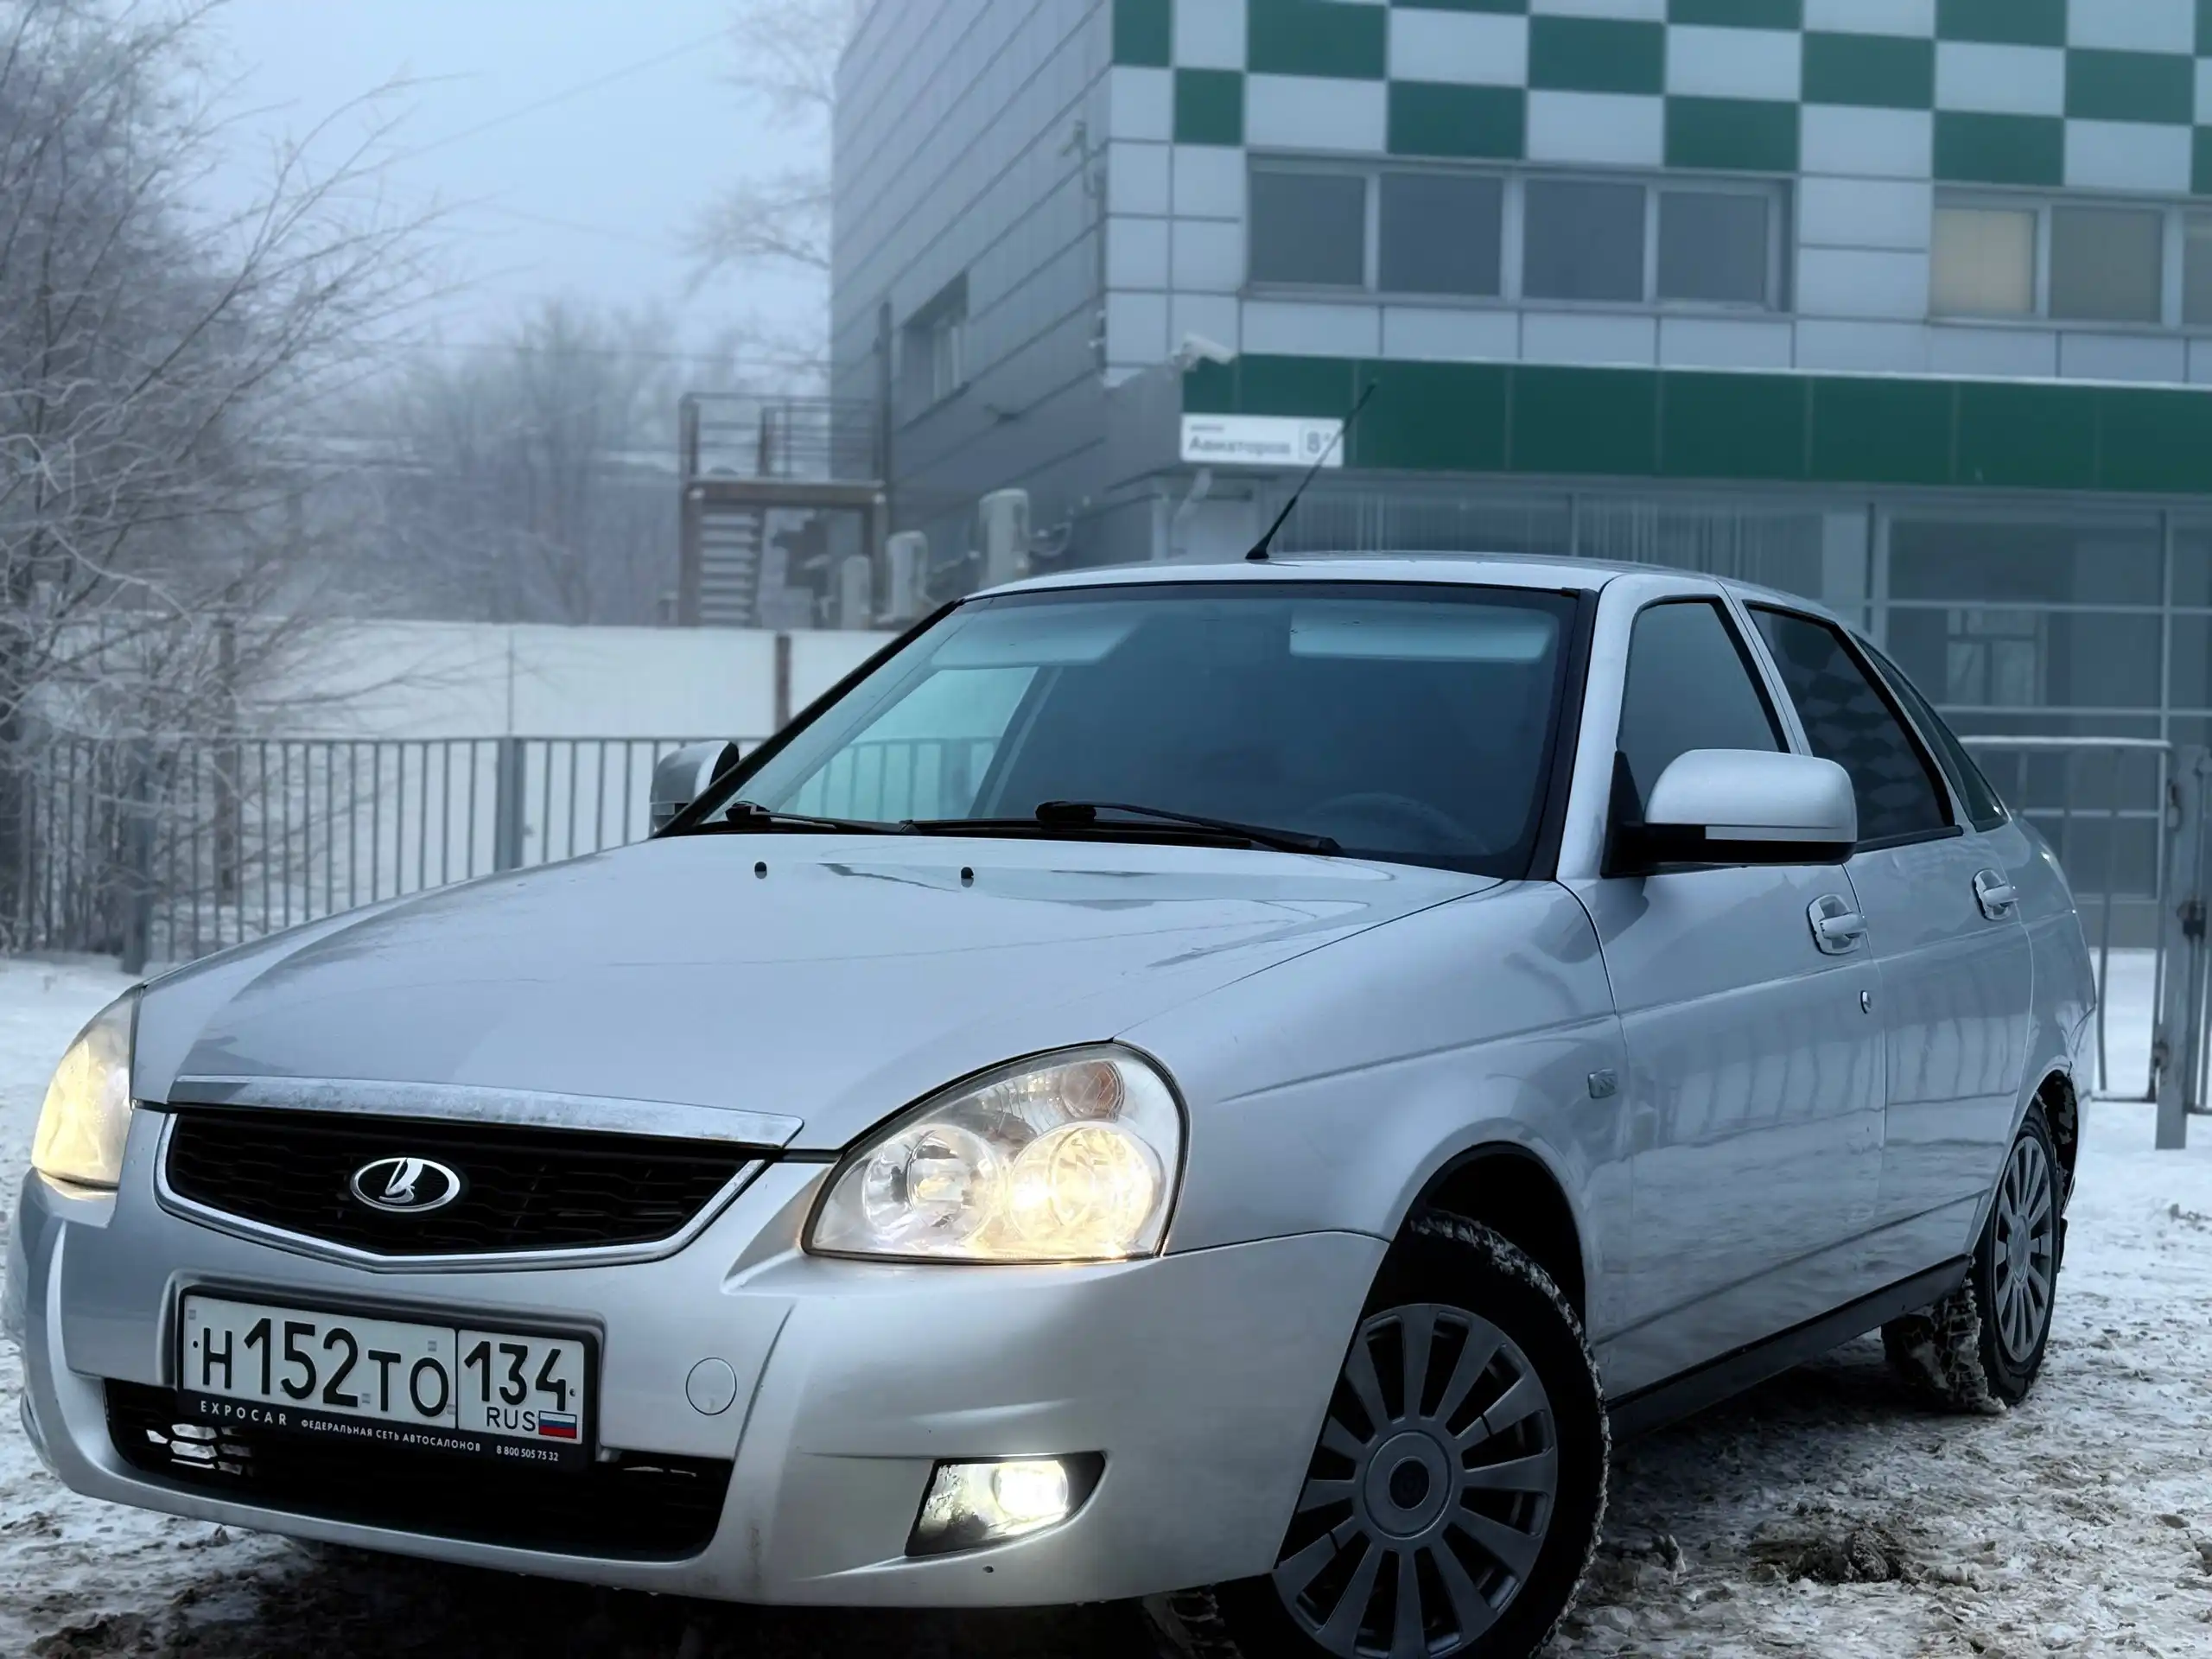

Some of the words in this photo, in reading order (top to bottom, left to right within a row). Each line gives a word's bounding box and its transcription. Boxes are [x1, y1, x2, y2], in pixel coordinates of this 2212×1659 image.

[463, 1340, 567, 1412] 134
[200, 1400, 287, 1426] EXPOCAR
[486, 1407, 536, 1432] RUS
[301, 1420, 372, 1437] ФЕДЕРАЛЬНАЯ
[376, 1429, 399, 1441] СЕТЬ
[403, 1433, 480, 1452] АВТОСАЛОНОВ
[496, 1445, 502, 1455] 8
[504, 1446, 519, 1458] 800
[521, 1448, 536, 1459] 505
[537, 1450, 547, 1460] 75
[549, 1452, 559, 1462] 32
